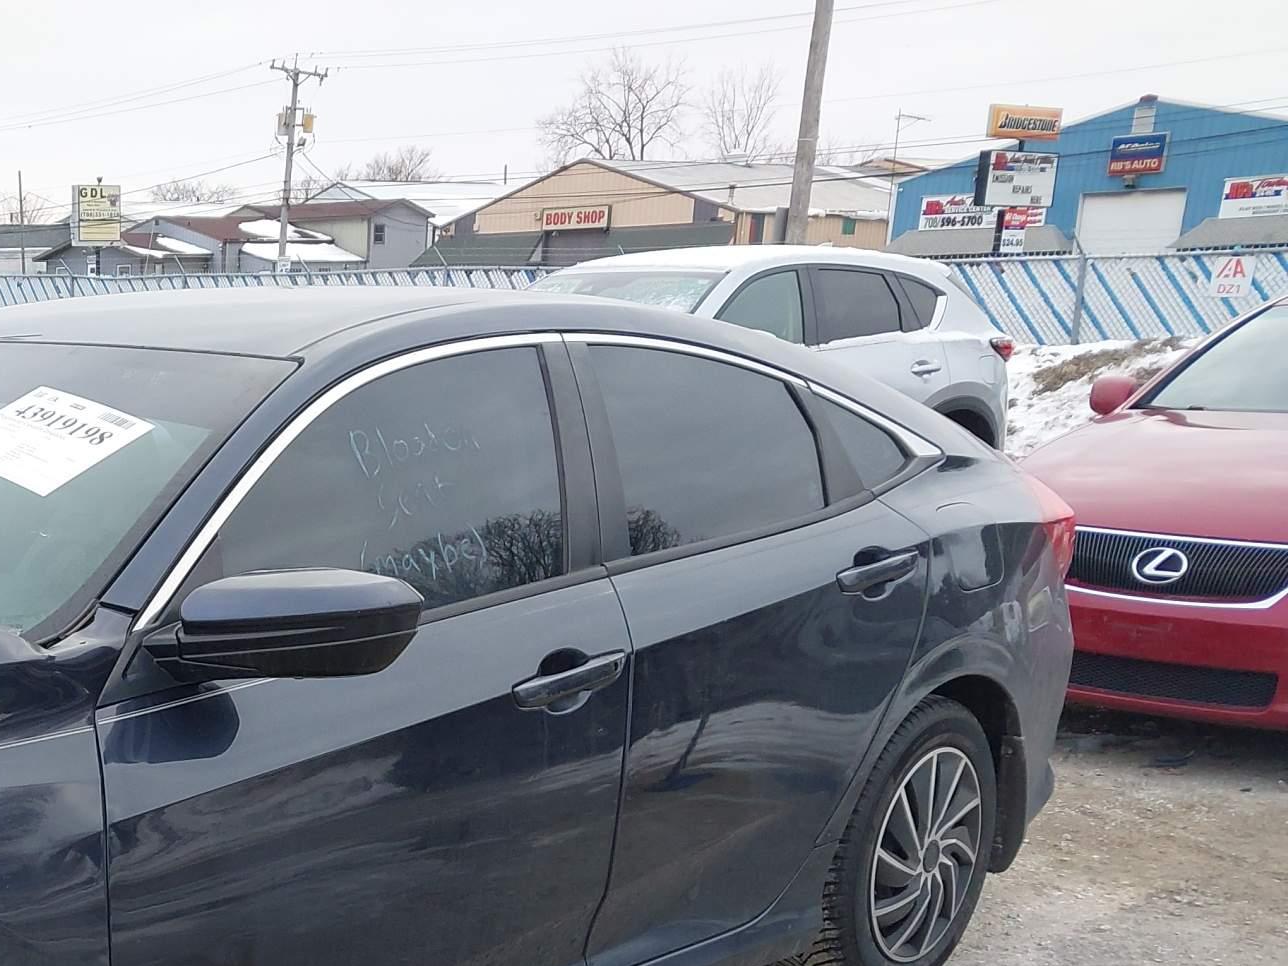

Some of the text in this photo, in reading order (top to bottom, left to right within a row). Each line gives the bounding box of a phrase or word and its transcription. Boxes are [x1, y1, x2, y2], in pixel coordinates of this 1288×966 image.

[998, 113, 1059, 132] BRIDGESTONE
[1132, 159, 1158, 169] AUTO
[80, 188, 107, 199] GDL
[545, 210, 605, 225] BODY SHOP
[15, 404, 113, 446] 43919198
